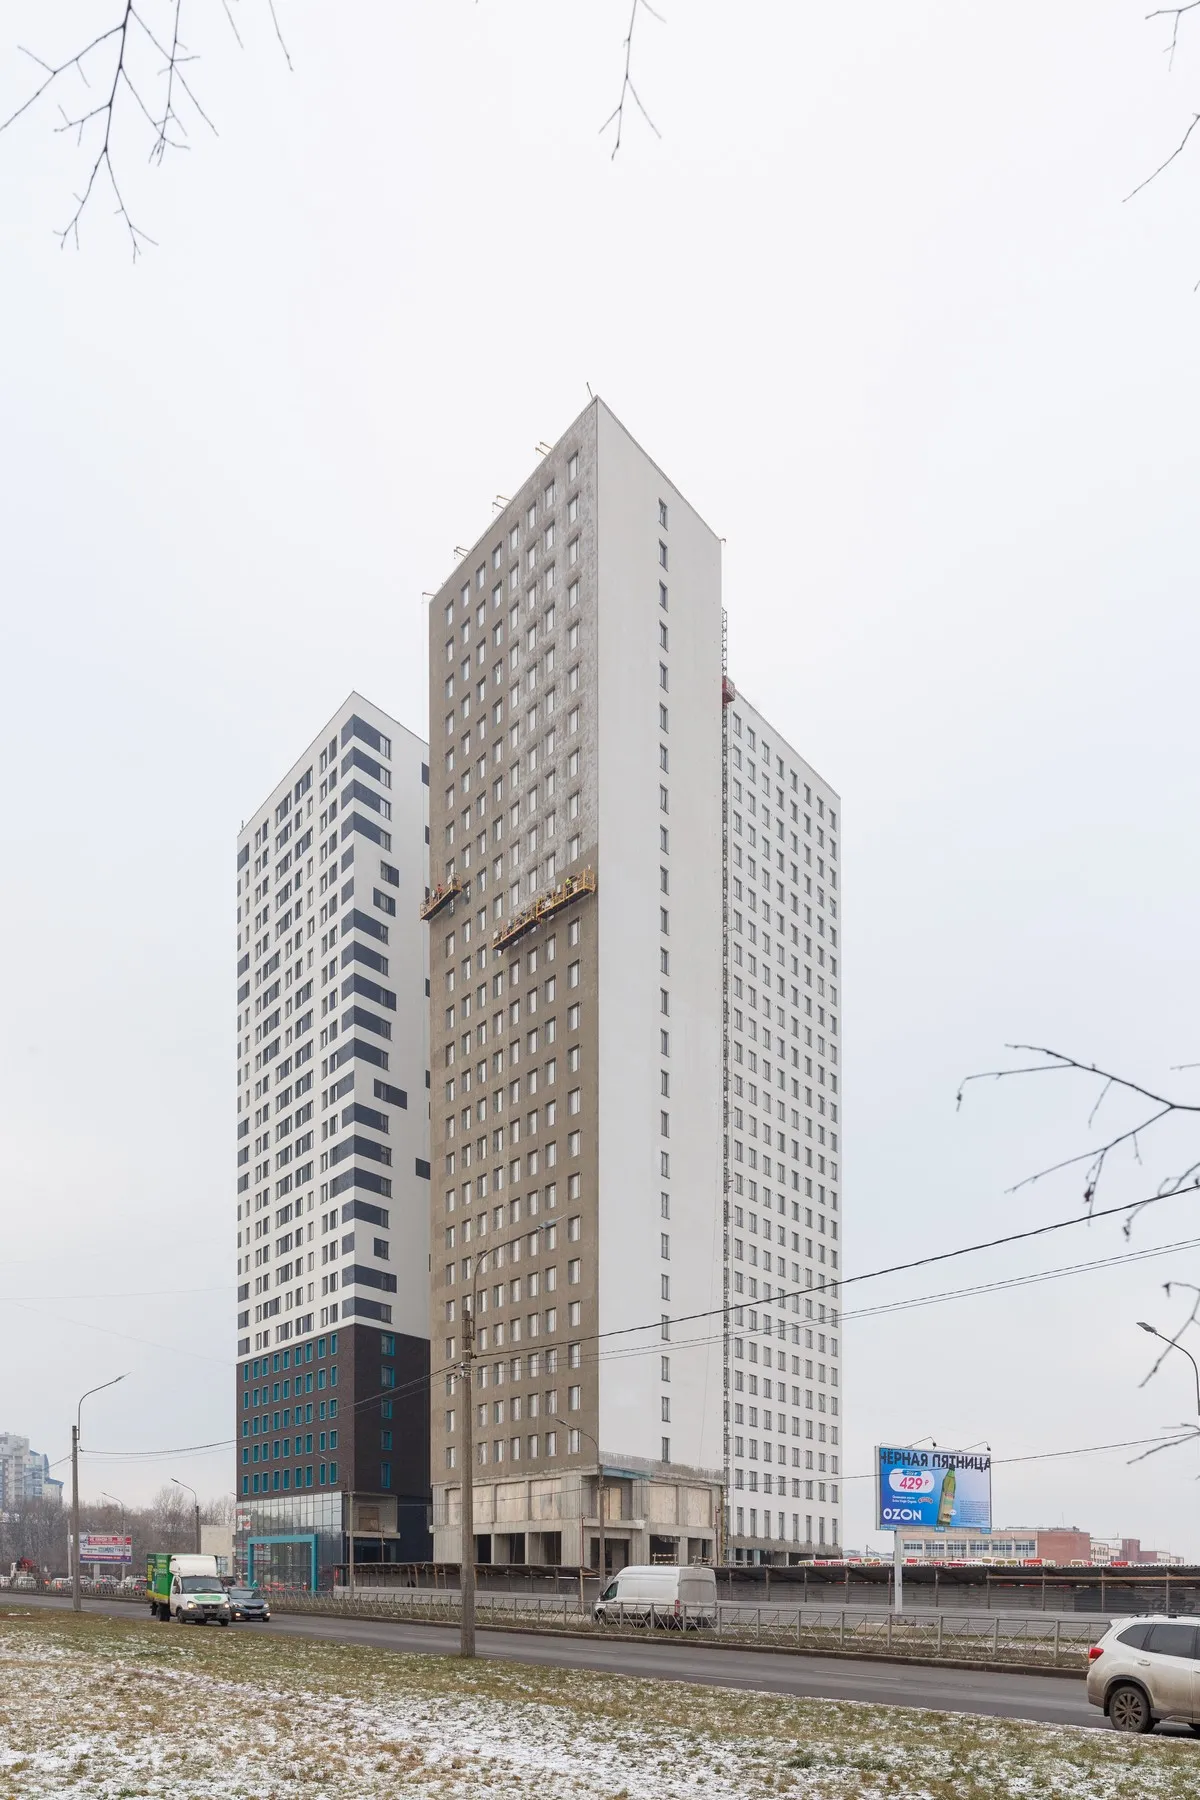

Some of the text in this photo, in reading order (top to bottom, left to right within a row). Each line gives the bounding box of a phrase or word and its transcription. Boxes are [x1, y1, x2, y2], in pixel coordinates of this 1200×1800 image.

[932, 1454, 991, 1472] ПЯТНИЦА
[899, 1476, 923, 1490] 429
[883, 1508, 922, 1520] OZON
